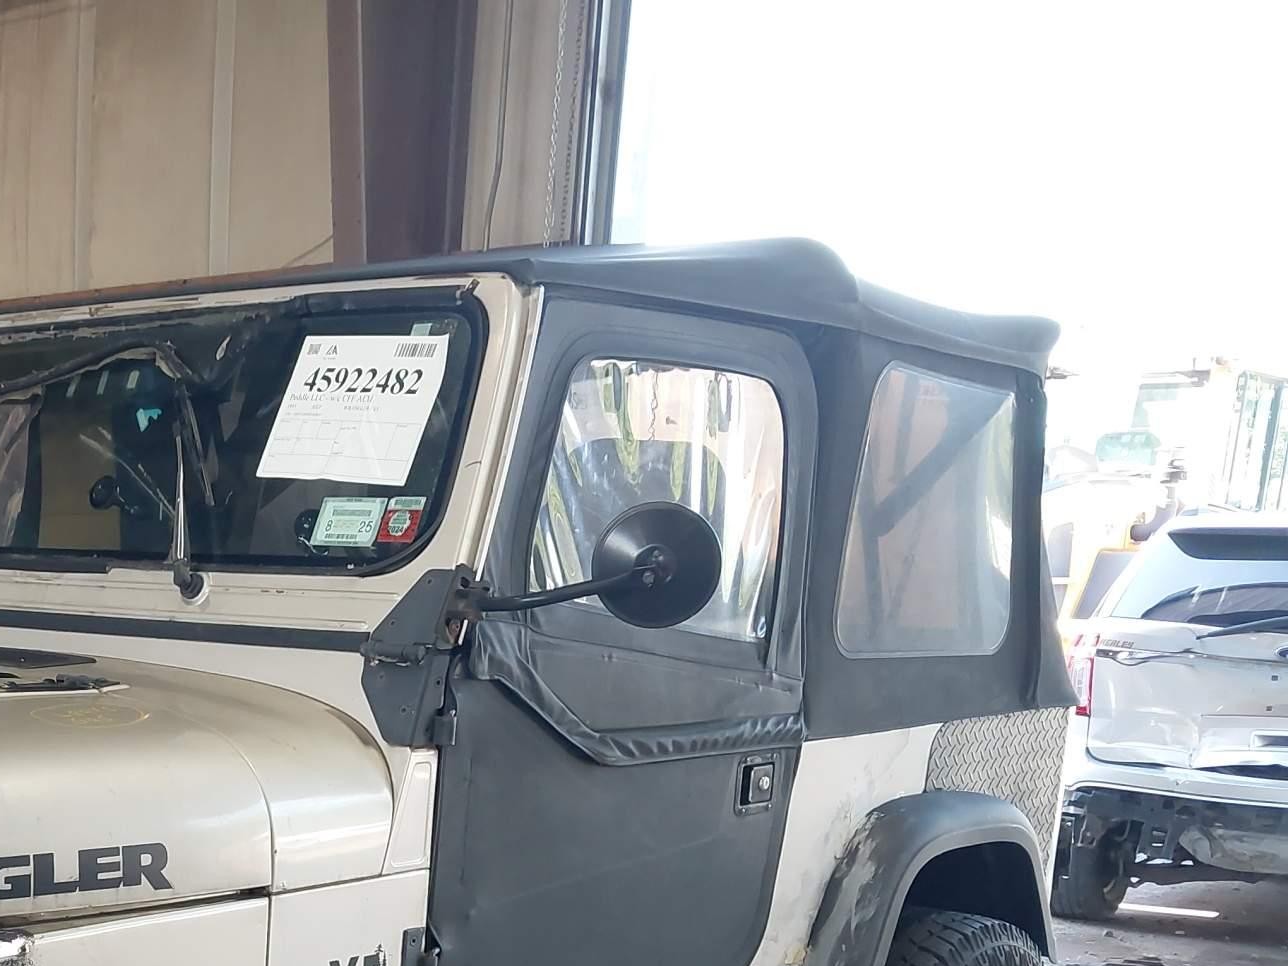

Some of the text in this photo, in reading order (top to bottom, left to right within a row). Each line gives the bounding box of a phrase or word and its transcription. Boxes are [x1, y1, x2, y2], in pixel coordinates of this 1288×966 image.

[304, 367, 424, 395] 45922482
[325, 520, 333, 532] 8
[358, 520, 373, 533] 25
